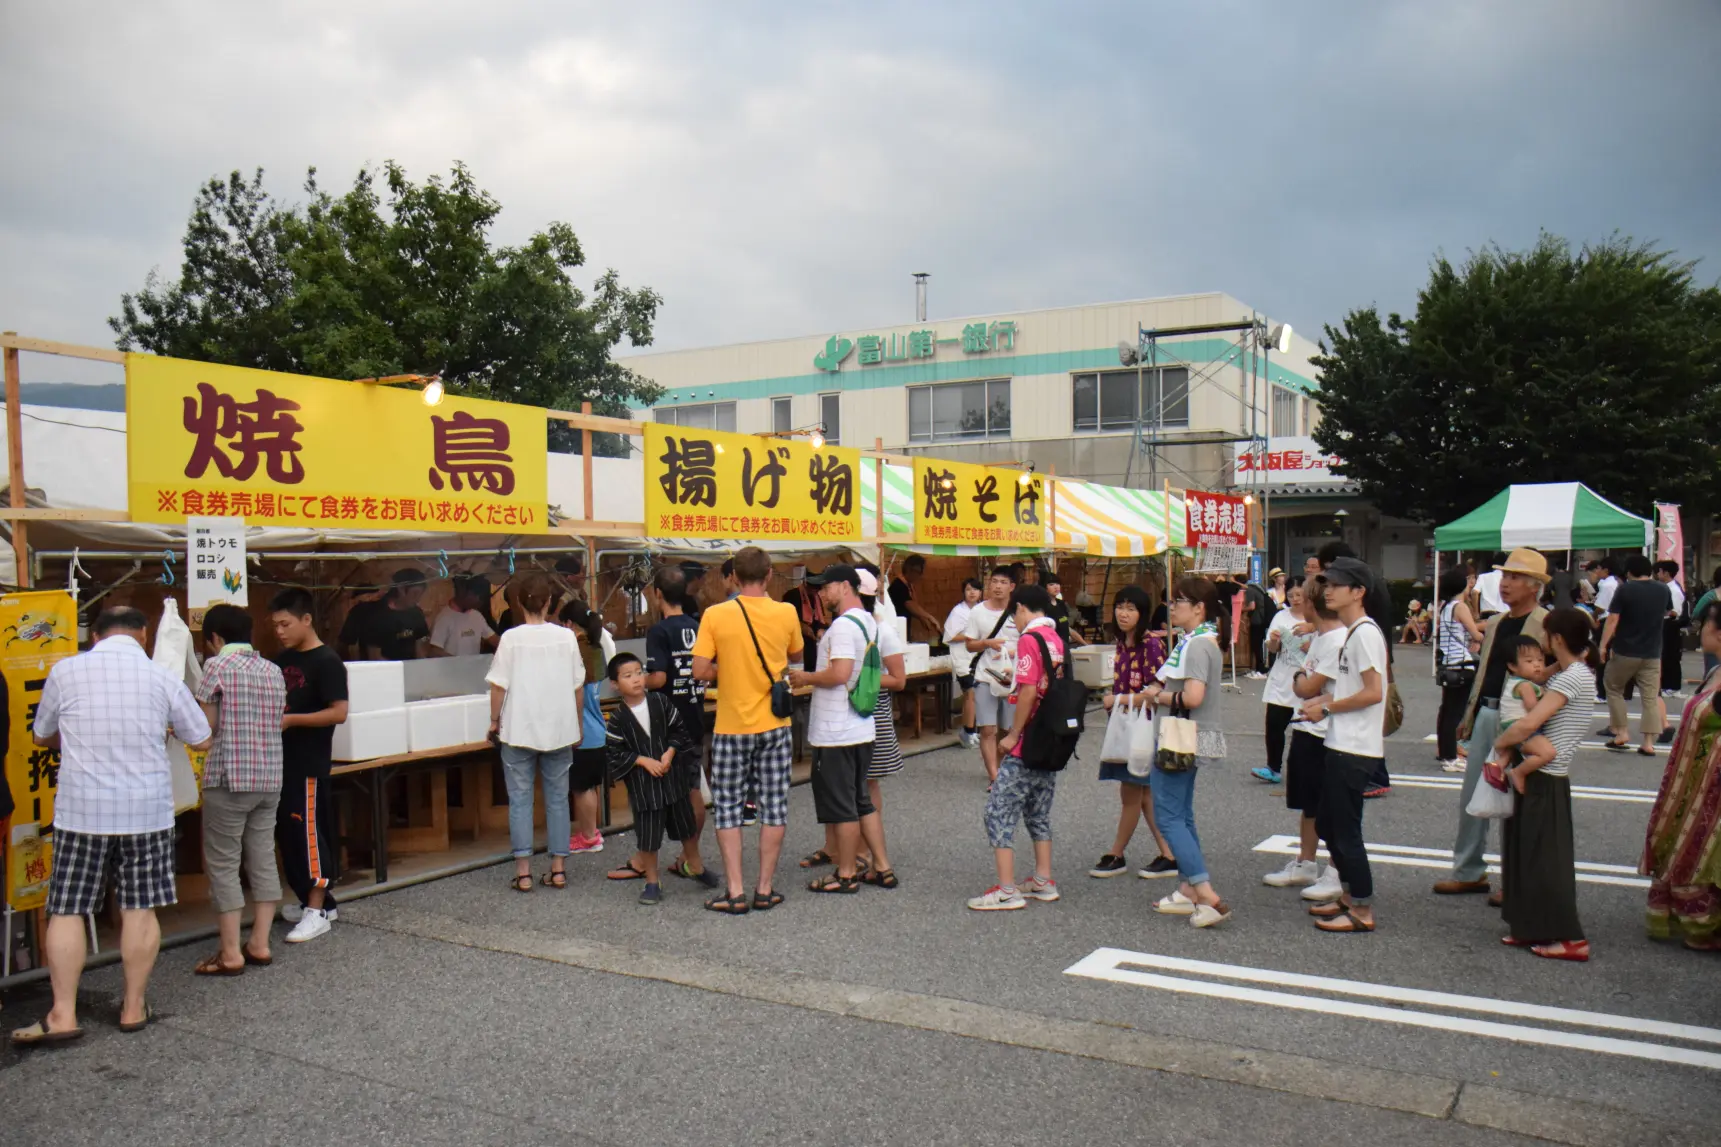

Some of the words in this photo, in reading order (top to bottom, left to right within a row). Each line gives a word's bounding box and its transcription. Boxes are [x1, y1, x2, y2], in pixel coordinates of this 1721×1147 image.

[857, 320, 1017, 365] 富山第一銀行
[659, 436, 853, 516] 揚げ物
[923, 466, 1041, 526] 焼そば
[157, 489, 533, 526] ※食券売場にて食券をお買い求めください
[1188, 496, 1246, 536] 食券売場
[197, 538, 238, 549] 焼トウモ
[197, 569, 217, 579] 販売
